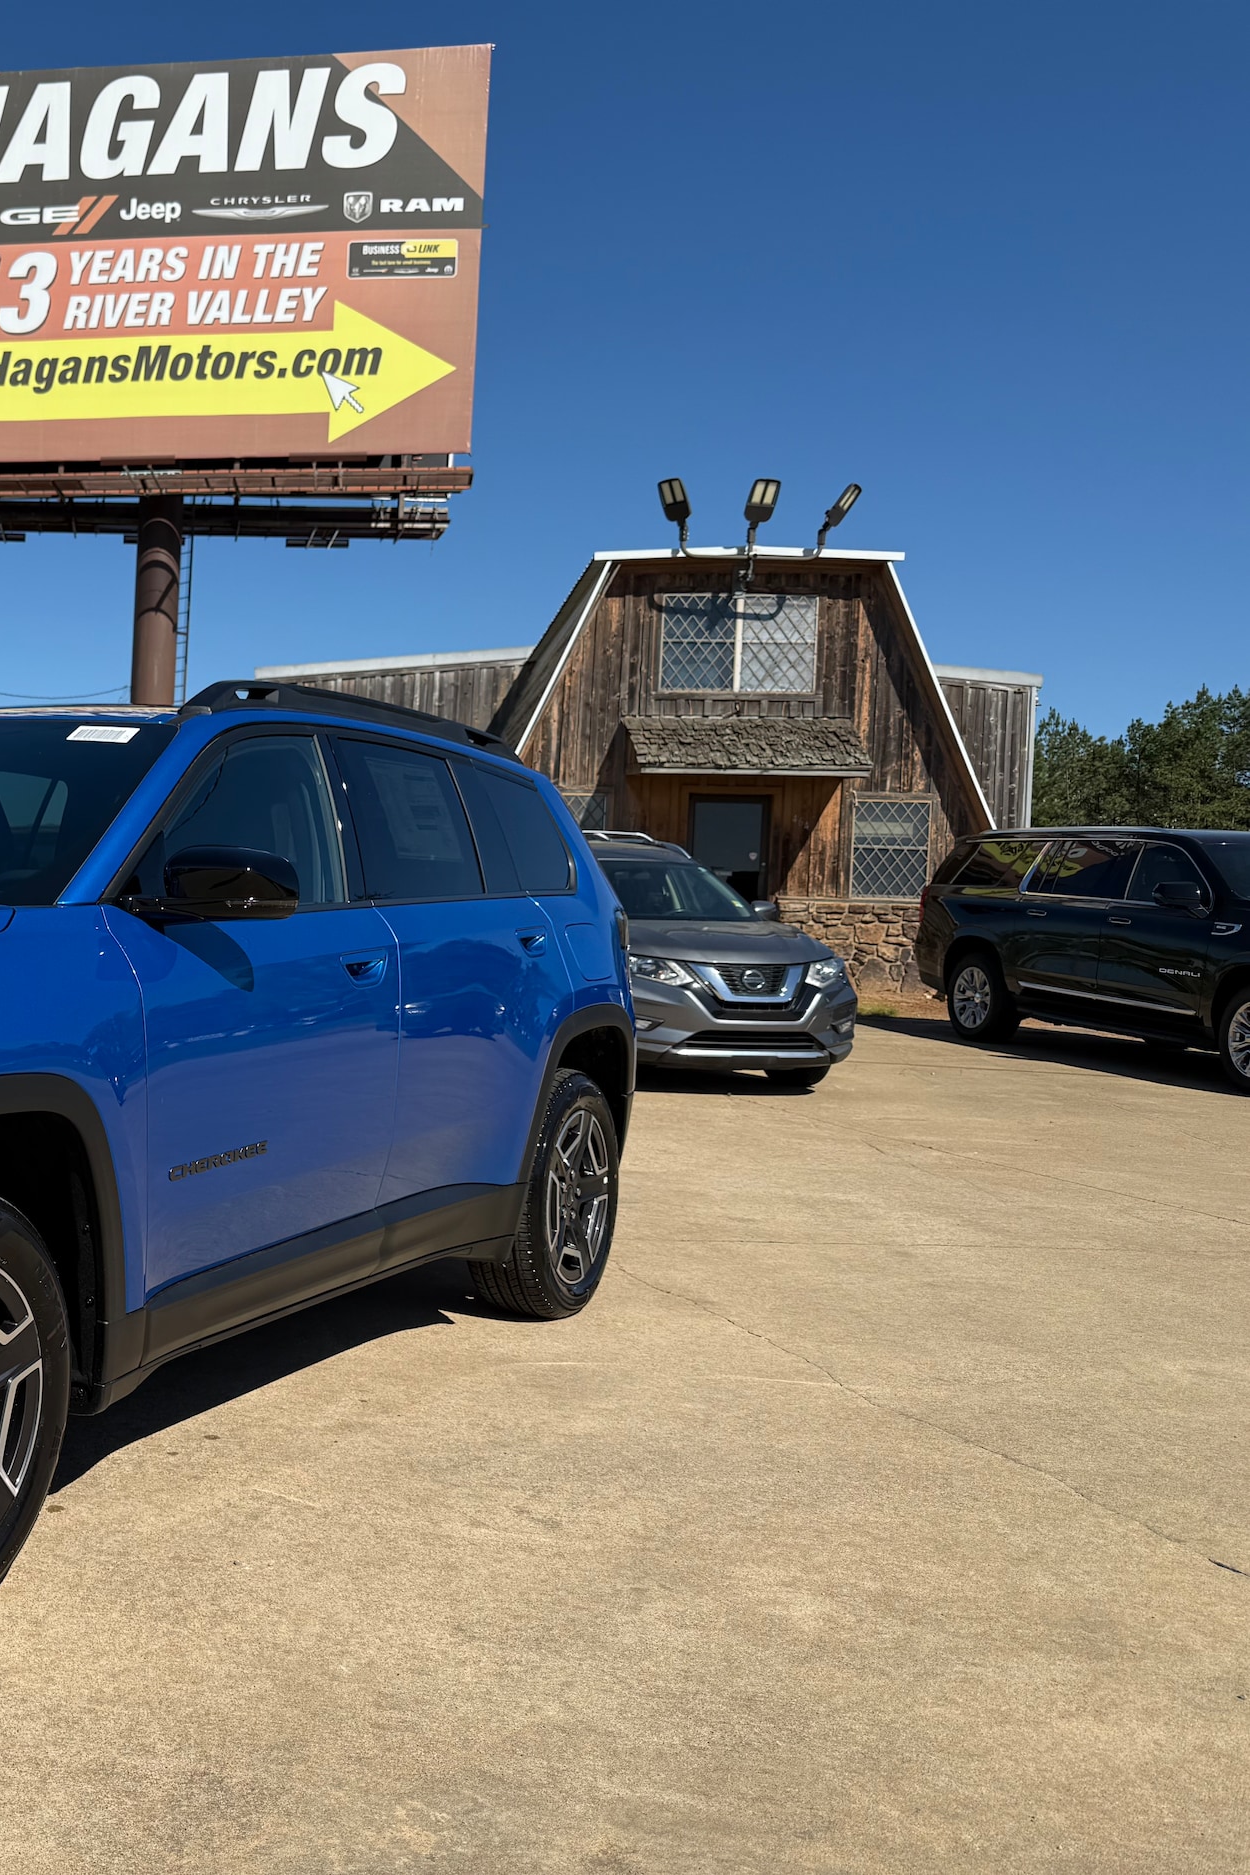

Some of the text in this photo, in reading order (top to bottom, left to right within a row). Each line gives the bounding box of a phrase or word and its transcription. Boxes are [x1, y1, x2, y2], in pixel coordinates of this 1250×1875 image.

[210, 194, 311, 206] CHRYSLER
[379, 197, 465, 213] RAM
[119, 198, 182, 223] Jeep
[418, 244, 440, 254] LINK
[68, 241, 325, 286] YEARS IN THE
[63, 286, 328, 331] RIVER VALLEY
[1158, 967, 1201, 978] DENALI
[168, 1140, 269, 1182] CHEROKEE
